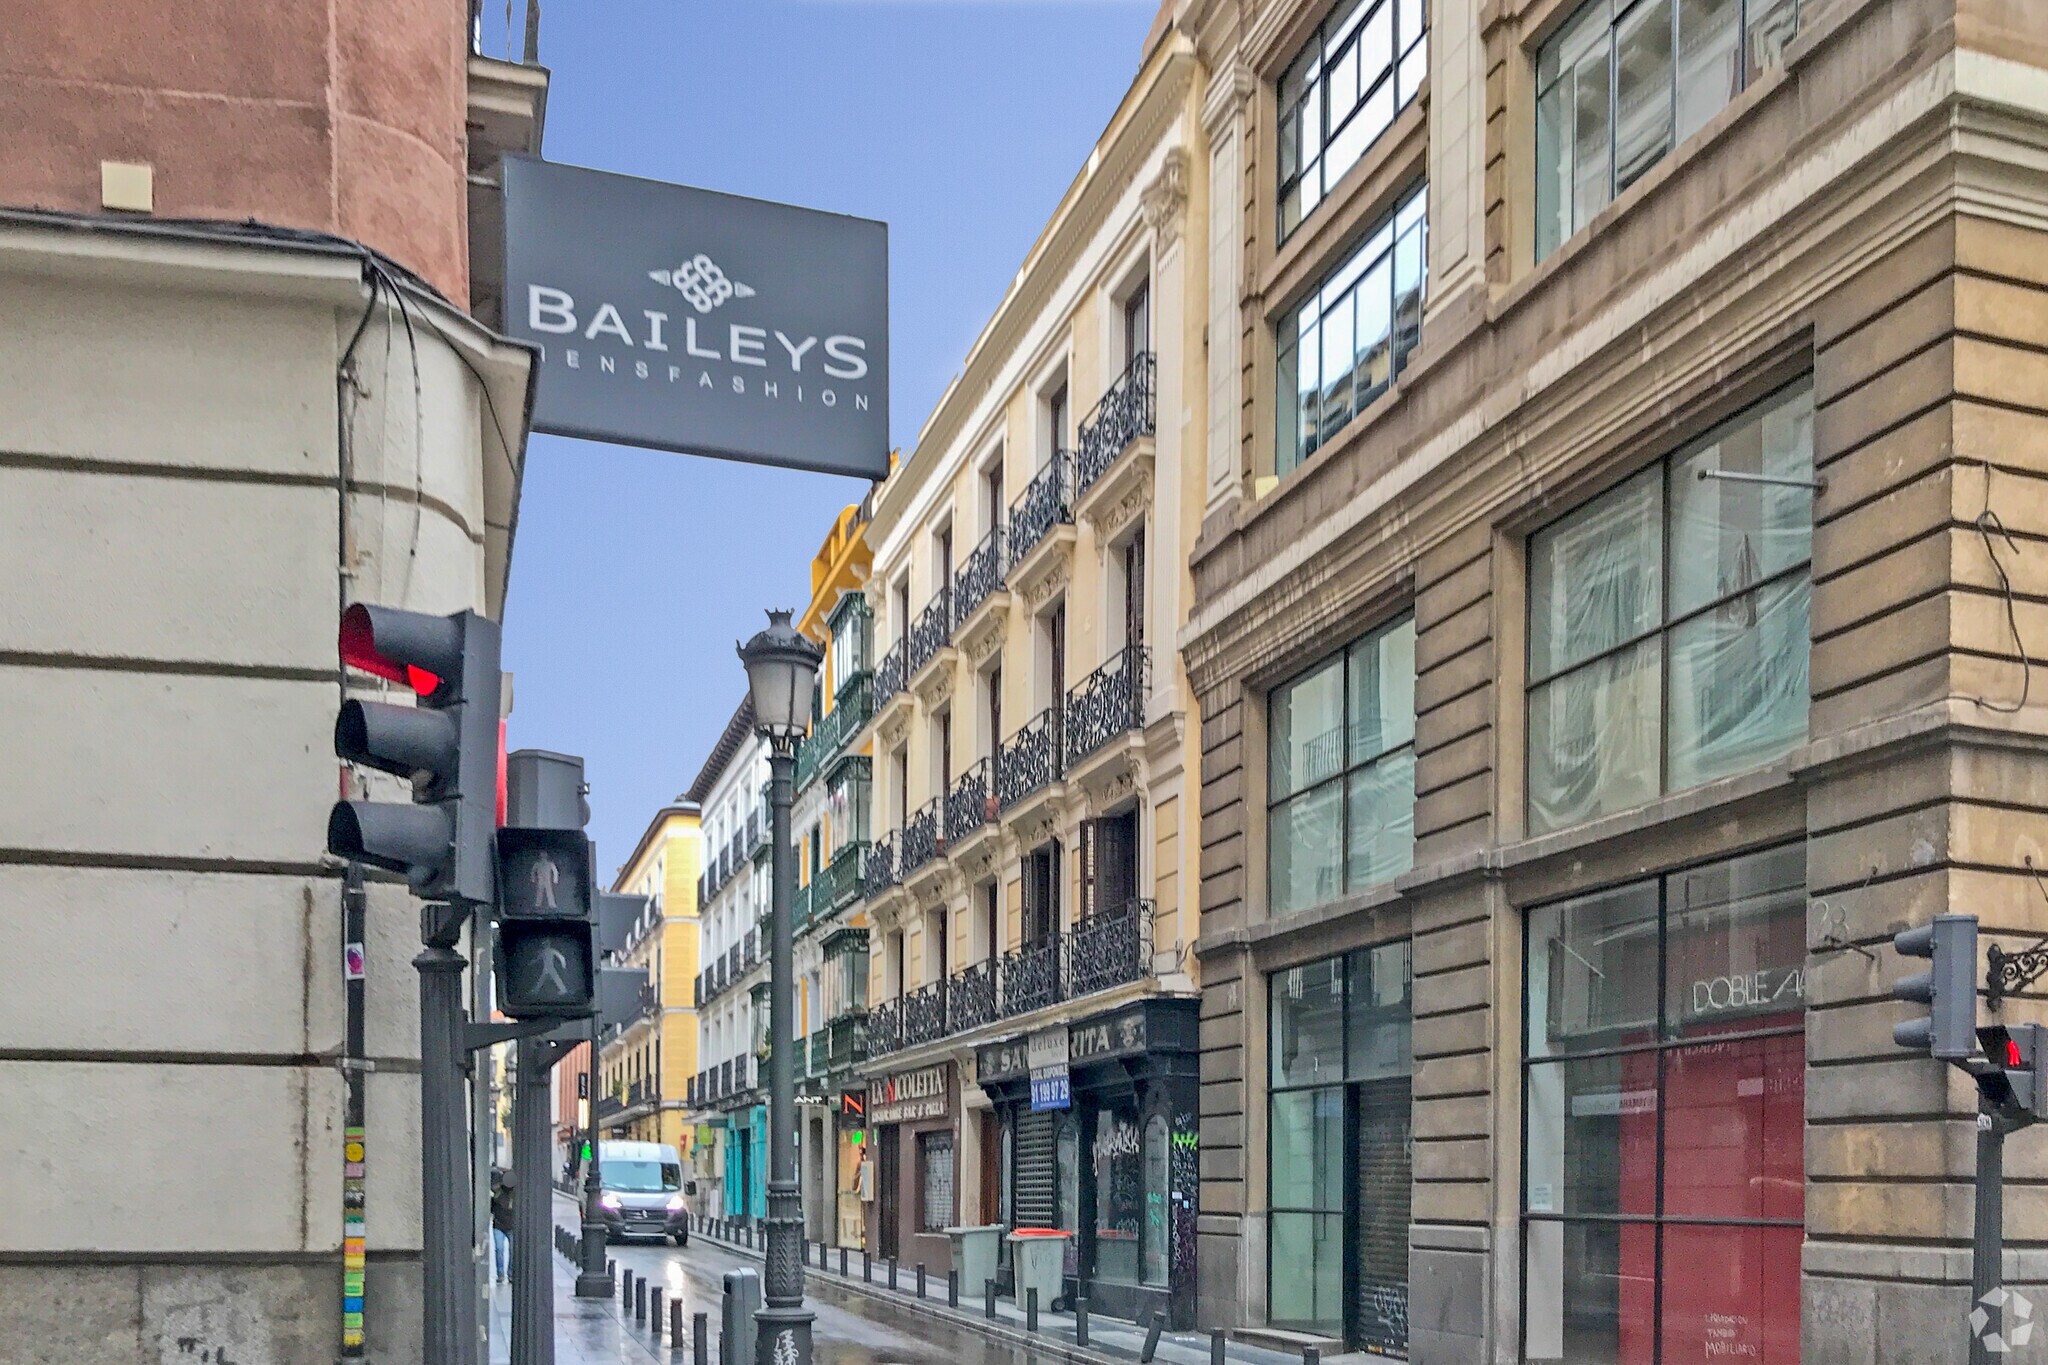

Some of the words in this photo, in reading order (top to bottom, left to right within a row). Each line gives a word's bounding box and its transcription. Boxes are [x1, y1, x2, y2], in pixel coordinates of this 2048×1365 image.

[528, 284, 869, 380] BAILEYS
[540, 345, 869, 411] ENSFASHION
[1693, 970, 1772, 1012] DOBLE
[1031, 1033, 1065, 1053] deluxe
[843, 1093, 863, 1114] N
[872, 1081, 883, 1105] LA
[886, 1067, 943, 1105] NICOLETTA
